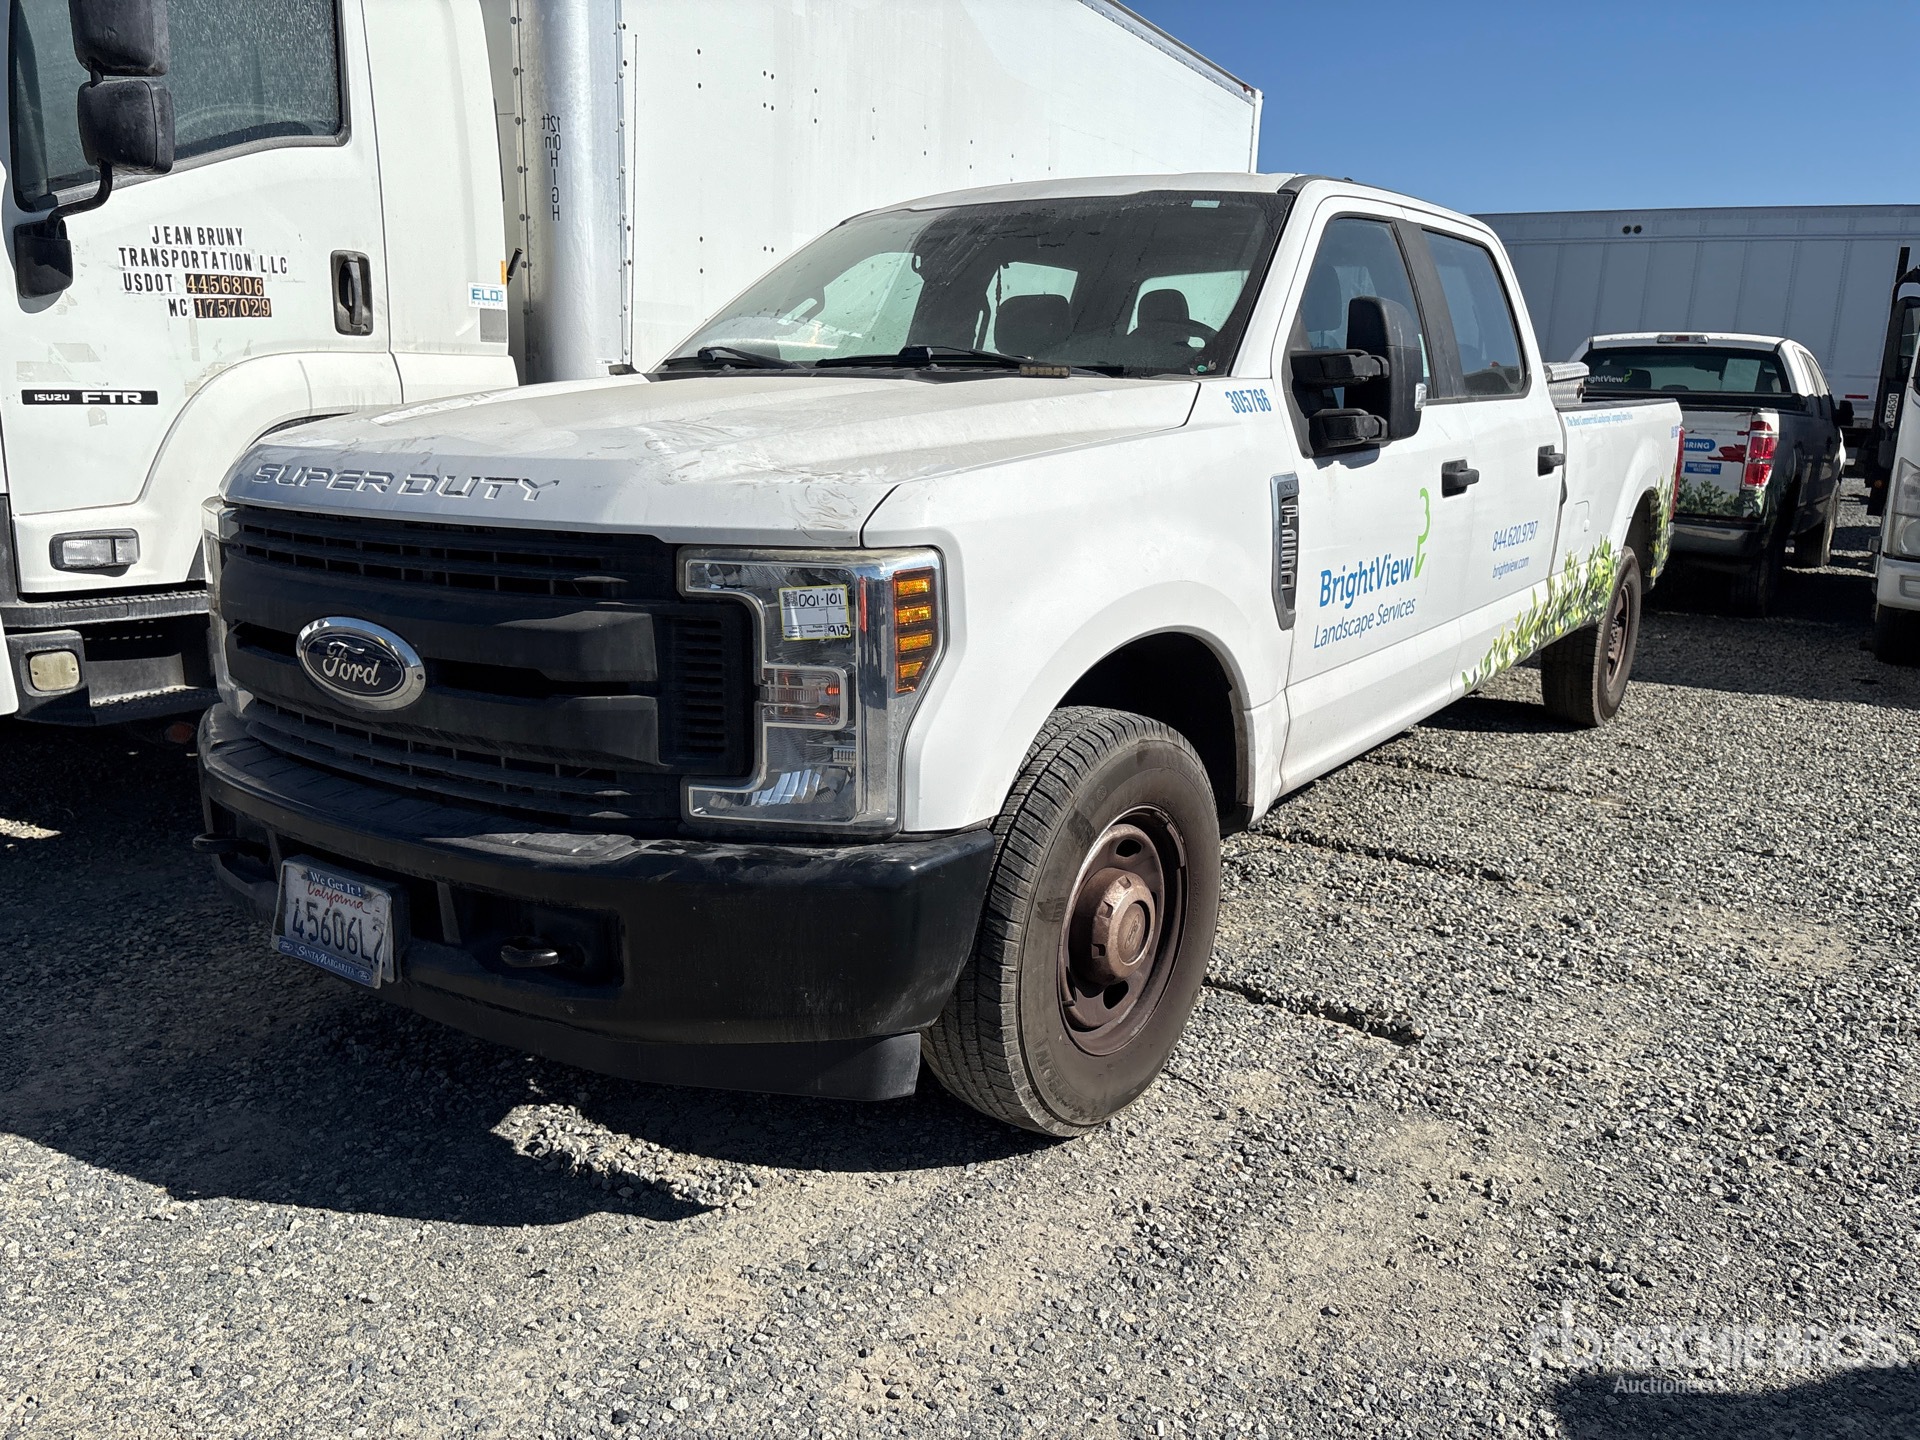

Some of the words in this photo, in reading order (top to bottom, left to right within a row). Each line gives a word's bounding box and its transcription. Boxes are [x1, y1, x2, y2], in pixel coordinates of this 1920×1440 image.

[151, 225, 193, 246] JEAN
[196, 226, 243, 247] BRUNY
[118, 247, 253, 272] TRANSPORTATION
[259, 254, 288, 275] LLC
[122, 272, 173, 293] USDOT
[186, 274, 264, 297] 4456806
[167, 298, 188, 317] MC
[194, 298, 272, 318] 1757029
[1584, 374, 1624, 384] rightView
[34, 393, 71, 402] ISUZU
[81, 391, 143, 404] FTR
[1224, 388, 1272, 414] 305766
[1886, 394, 1898, 419] 54630
[1684, 442, 1711, 450] IRING
[251, 463, 395, 494] SUPER
[397, 473, 561, 502] DUTY
[1492, 520, 1539, 552] 844.620.9797
[1492, 555, 1530, 580] brightview.com
[1319, 553, 1414, 609] BrightView
[828, 625, 850, 636] 9123
[1313, 612, 1375, 649] Landscape
[1375, 597, 1416, 627] Services
[322, 640, 381, 687] Ford
[310, 871, 326, 885] We
[327, 877, 344, 893] Get
[346, 883, 356, 894] It
[307, 882, 371, 915] California
